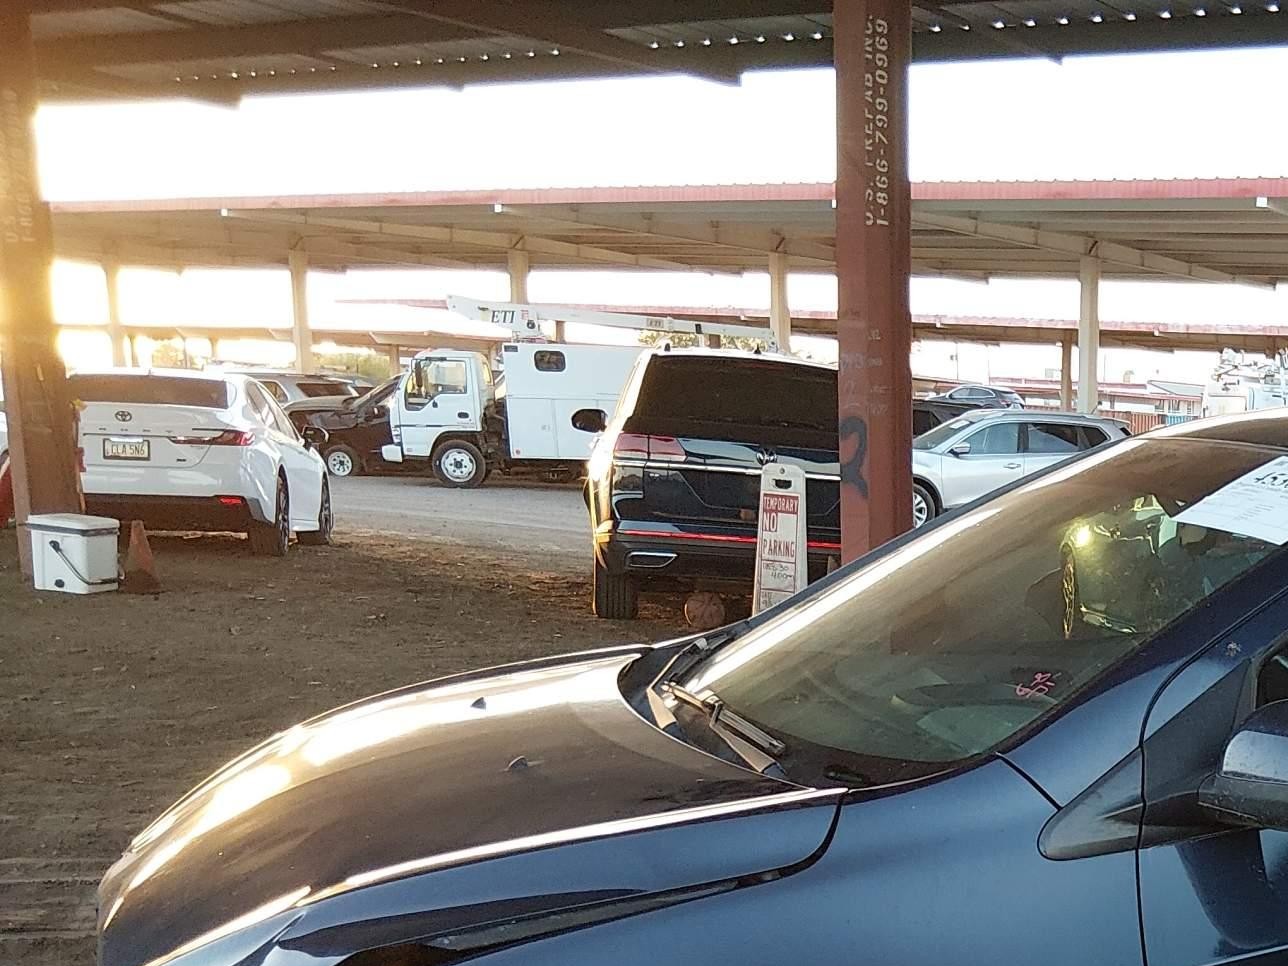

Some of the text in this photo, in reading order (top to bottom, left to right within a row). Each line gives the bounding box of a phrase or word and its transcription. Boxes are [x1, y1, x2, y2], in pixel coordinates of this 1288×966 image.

[874, 18, 889, 226] 1-866-799-0969
[490, 310, 515, 324] ETI
[763, 496, 799, 514] TEMPORARY
[763, 512, 777, 532] NO
[763, 538, 795, 558] PARKING
